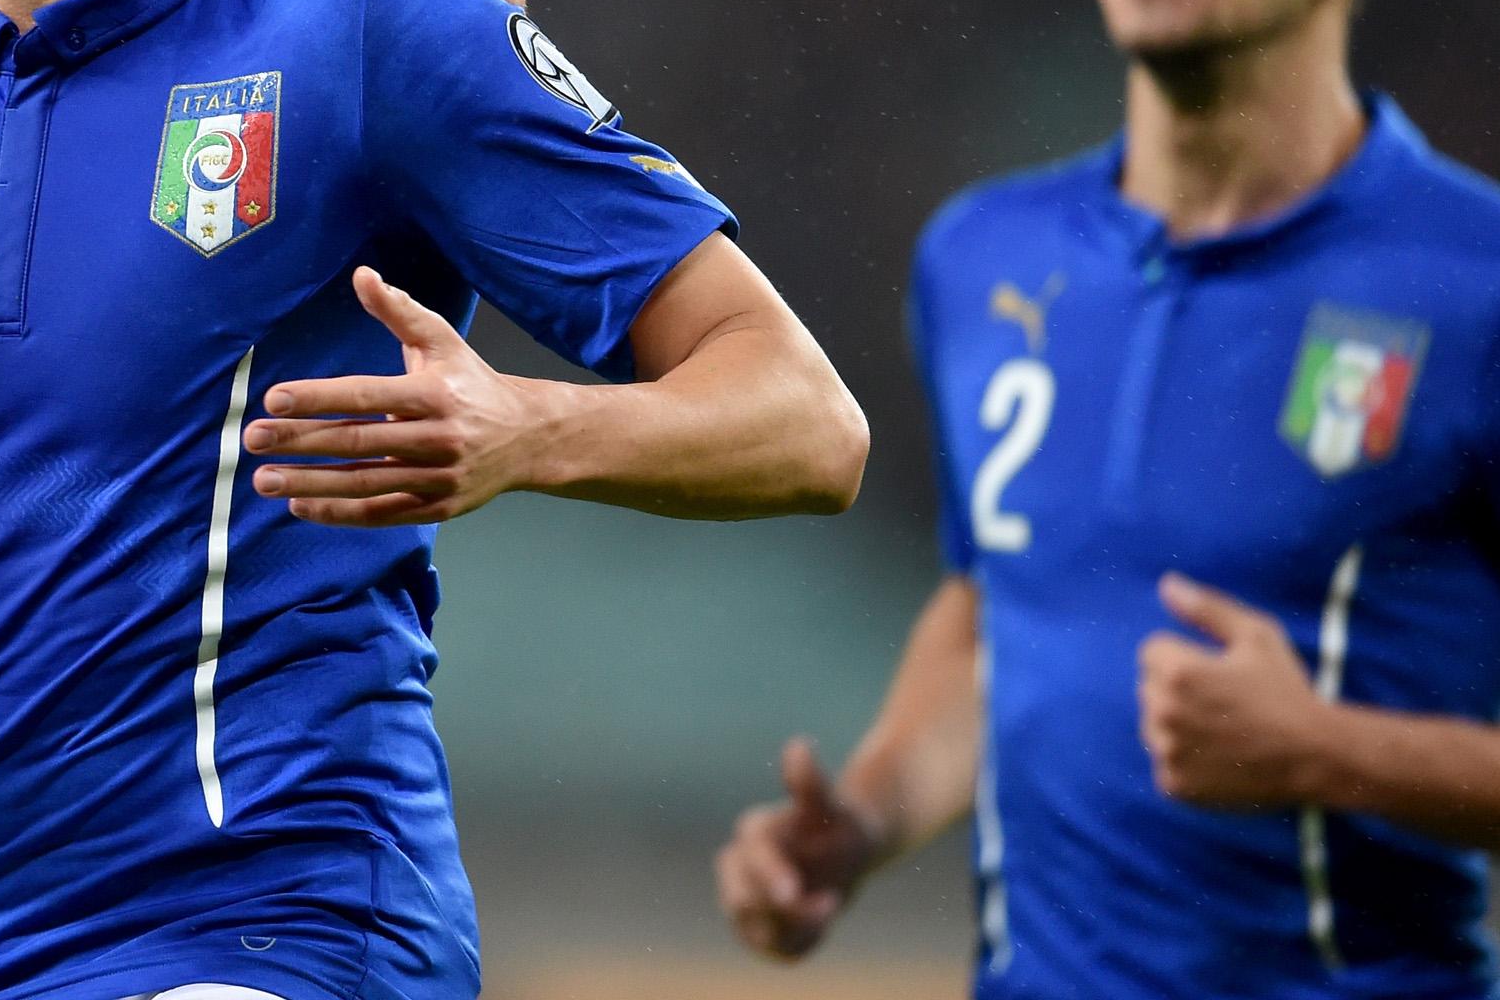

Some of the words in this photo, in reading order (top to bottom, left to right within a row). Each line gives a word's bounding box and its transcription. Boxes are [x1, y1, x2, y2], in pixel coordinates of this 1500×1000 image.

[183, 89, 264, 113] ITALIA
[201, 154, 229, 166] FIGC
[970, 356, 1056, 553] 2
